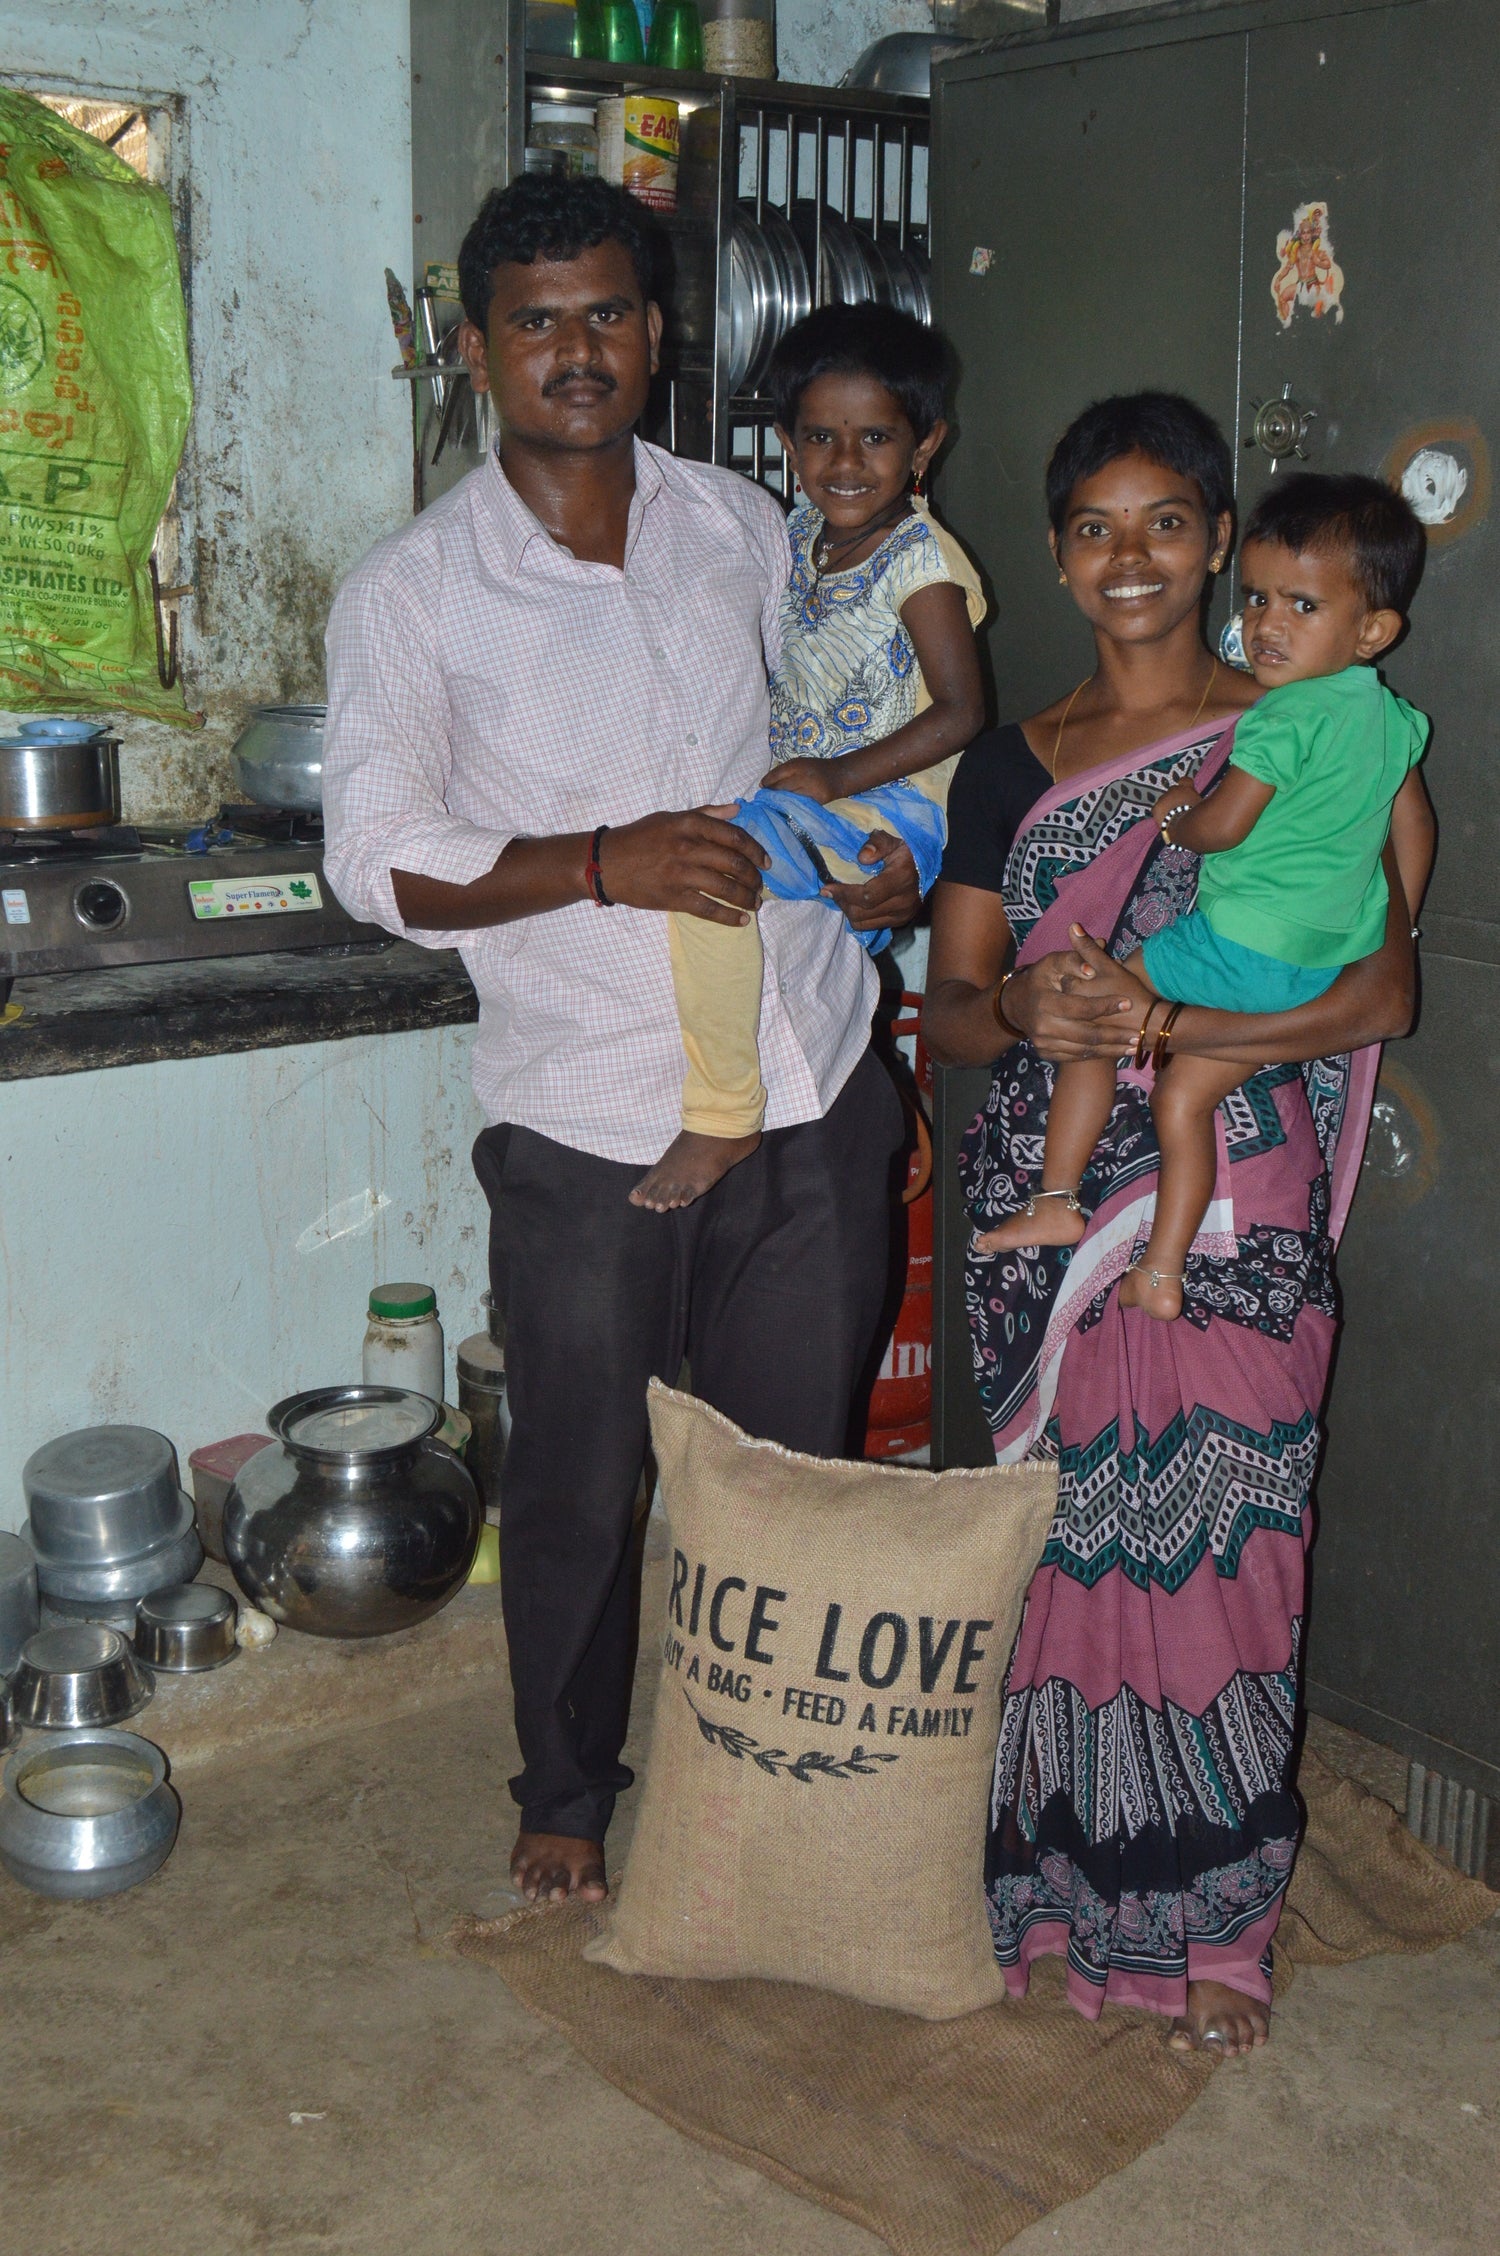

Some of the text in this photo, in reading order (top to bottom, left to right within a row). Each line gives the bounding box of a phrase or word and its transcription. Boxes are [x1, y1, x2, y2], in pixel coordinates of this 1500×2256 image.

[225, 891, 247, 902] Super
[668, 1547, 994, 1693] RICE LOVE
[686, 1653, 701, 1684] A
[707, 1662, 752, 1703] BAG
[782, 1686, 847, 1727] FEED
[857, 1702, 876, 1733] A
[886, 1705, 974, 1737] FAMILY
